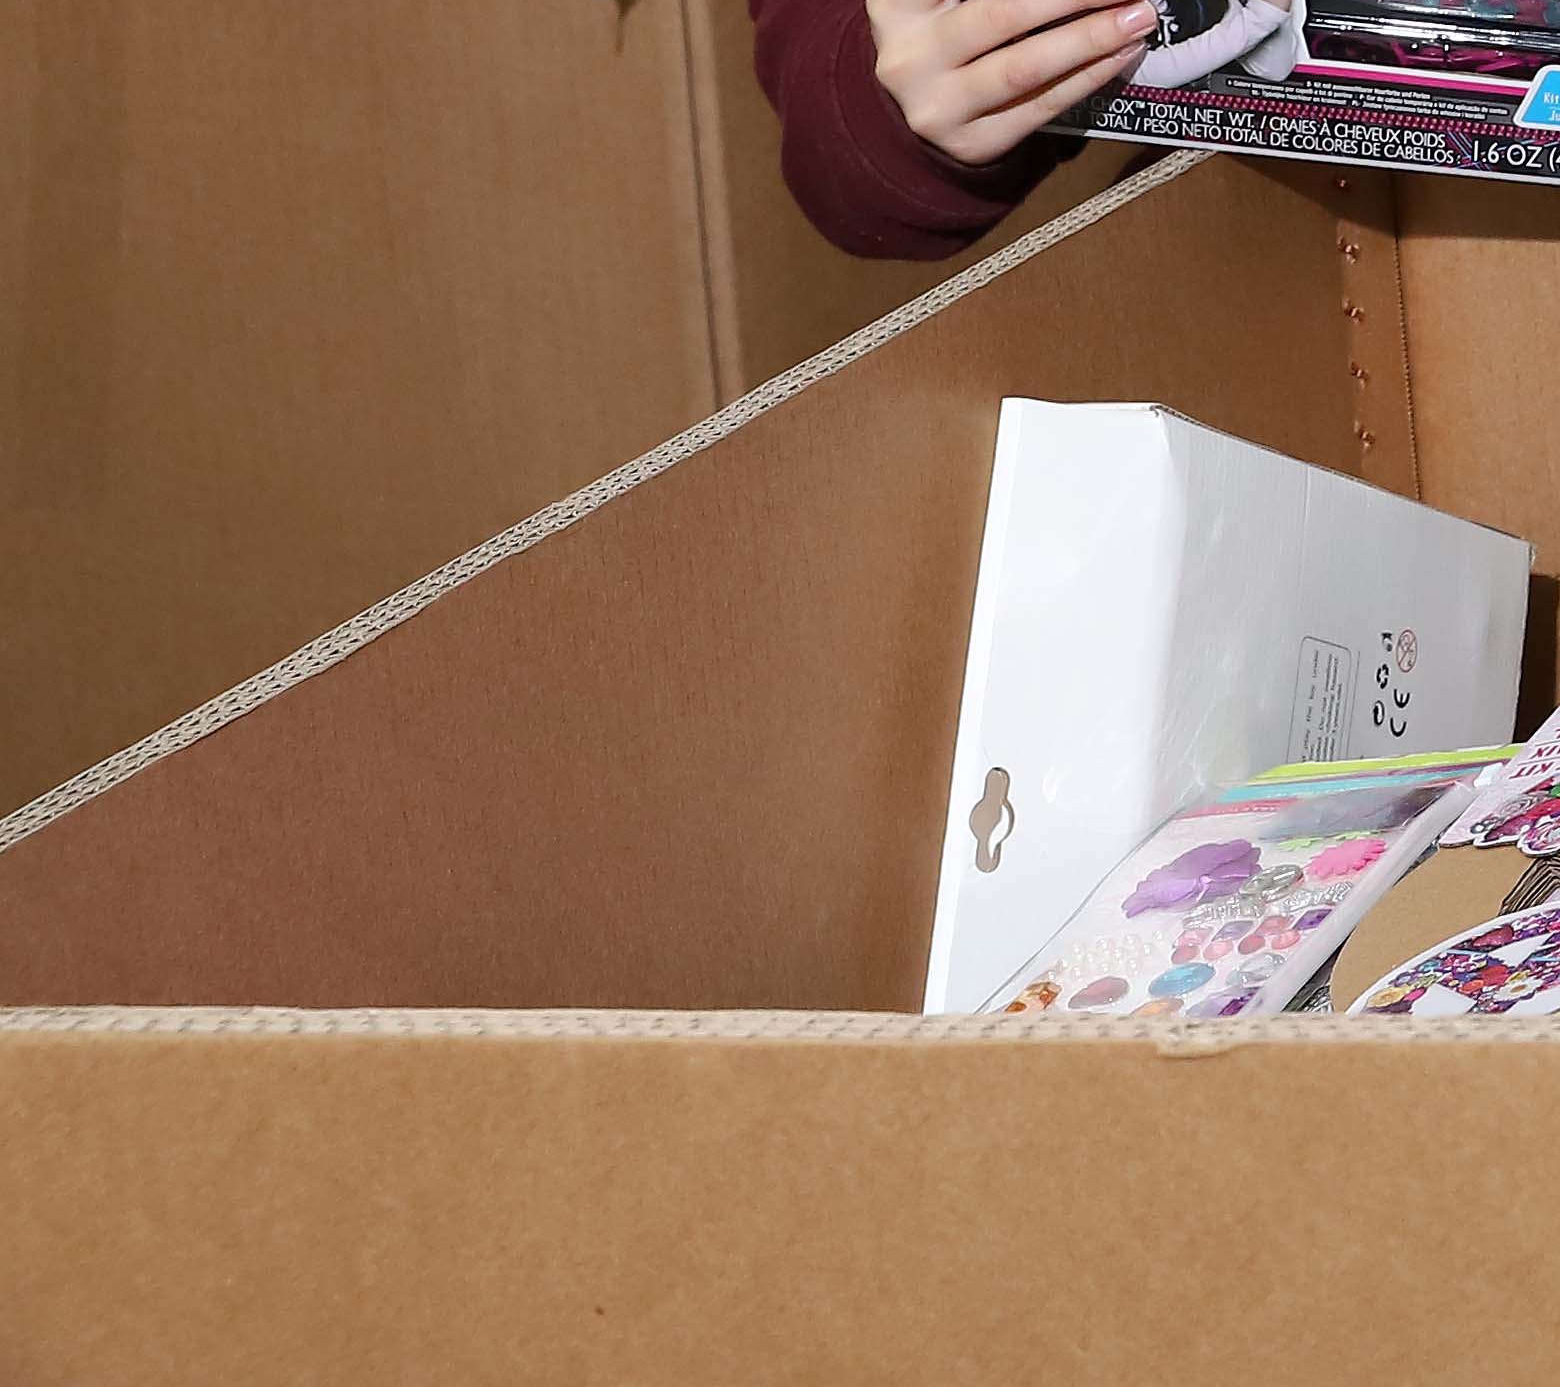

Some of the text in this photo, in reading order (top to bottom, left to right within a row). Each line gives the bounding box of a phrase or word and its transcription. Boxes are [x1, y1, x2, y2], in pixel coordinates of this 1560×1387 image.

[1543, 91, 1560, 105] Kit
[1147, 103, 1193, 122] TOTAL
[1194, 108, 1223, 126] NET
[1228, 112, 1256, 129] WT.
[1269, 116, 1317, 136] CRAIES
[1334, 121, 1401, 145] CHEVEUX
[1403, 130, 1447, 150] POIDS
[1143, 117, 1179, 135] PESO
[1181, 122, 1224, 143] NETO
[1223, 126, 1268, 146] TOTAL
[1270, 131, 1290, 149] DE
[1292, 134, 1359, 155] COLORES
[1361, 140, 1383, 158] DE
[1383, 143, 1455, 165] CABELLOS
[1472, 140, 1499, 163] 1.6
[1505, 144, 1544, 170] OZ
[1515, 761, 1555, 778] KIT
